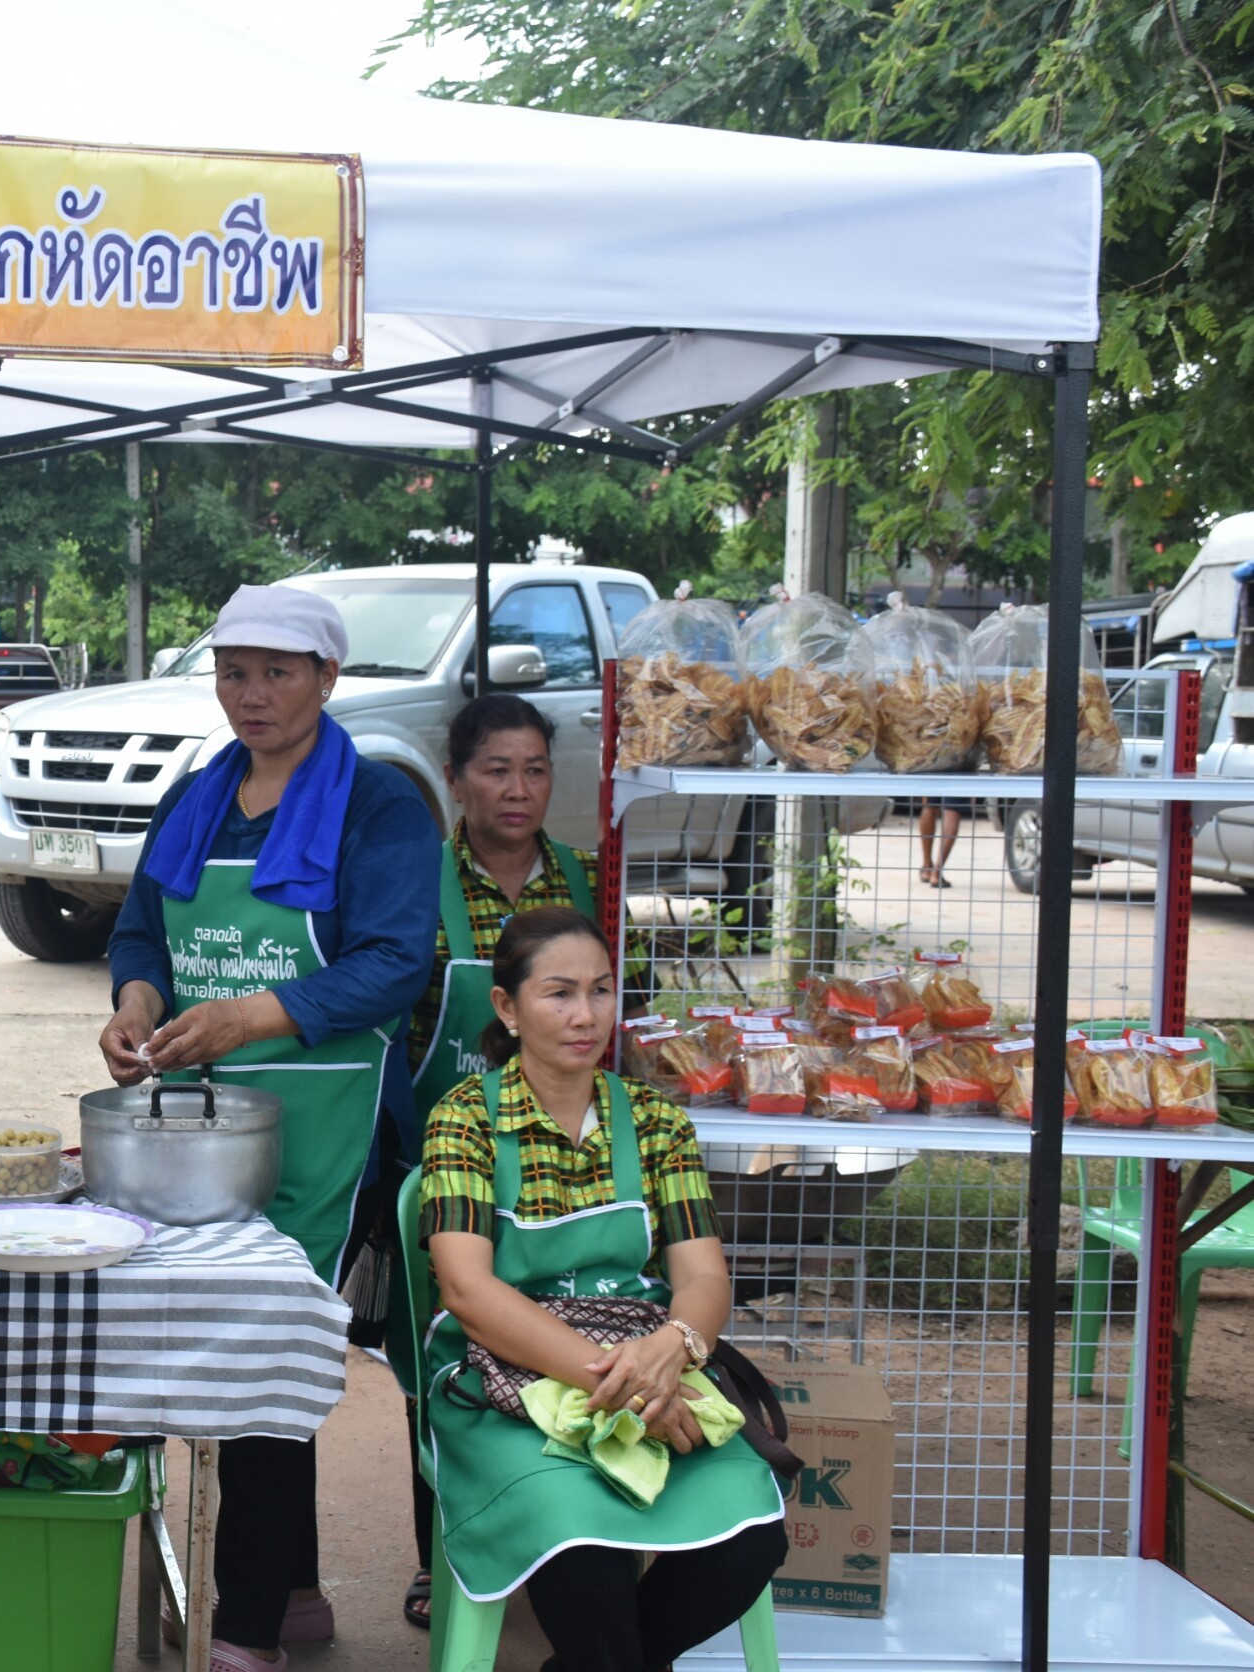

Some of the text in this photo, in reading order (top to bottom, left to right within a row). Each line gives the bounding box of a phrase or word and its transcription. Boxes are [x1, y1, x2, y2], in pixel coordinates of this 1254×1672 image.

[59, 834, 91, 855] 3501
[194, 925, 242, 943] ตลาดนัด
[790, 1423, 813, 1436] from
[817, 1425, 860, 1440] Pericarp
[811, 1586, 821, 1599] 6
[825, 1587, 873, 1604] Bottles
